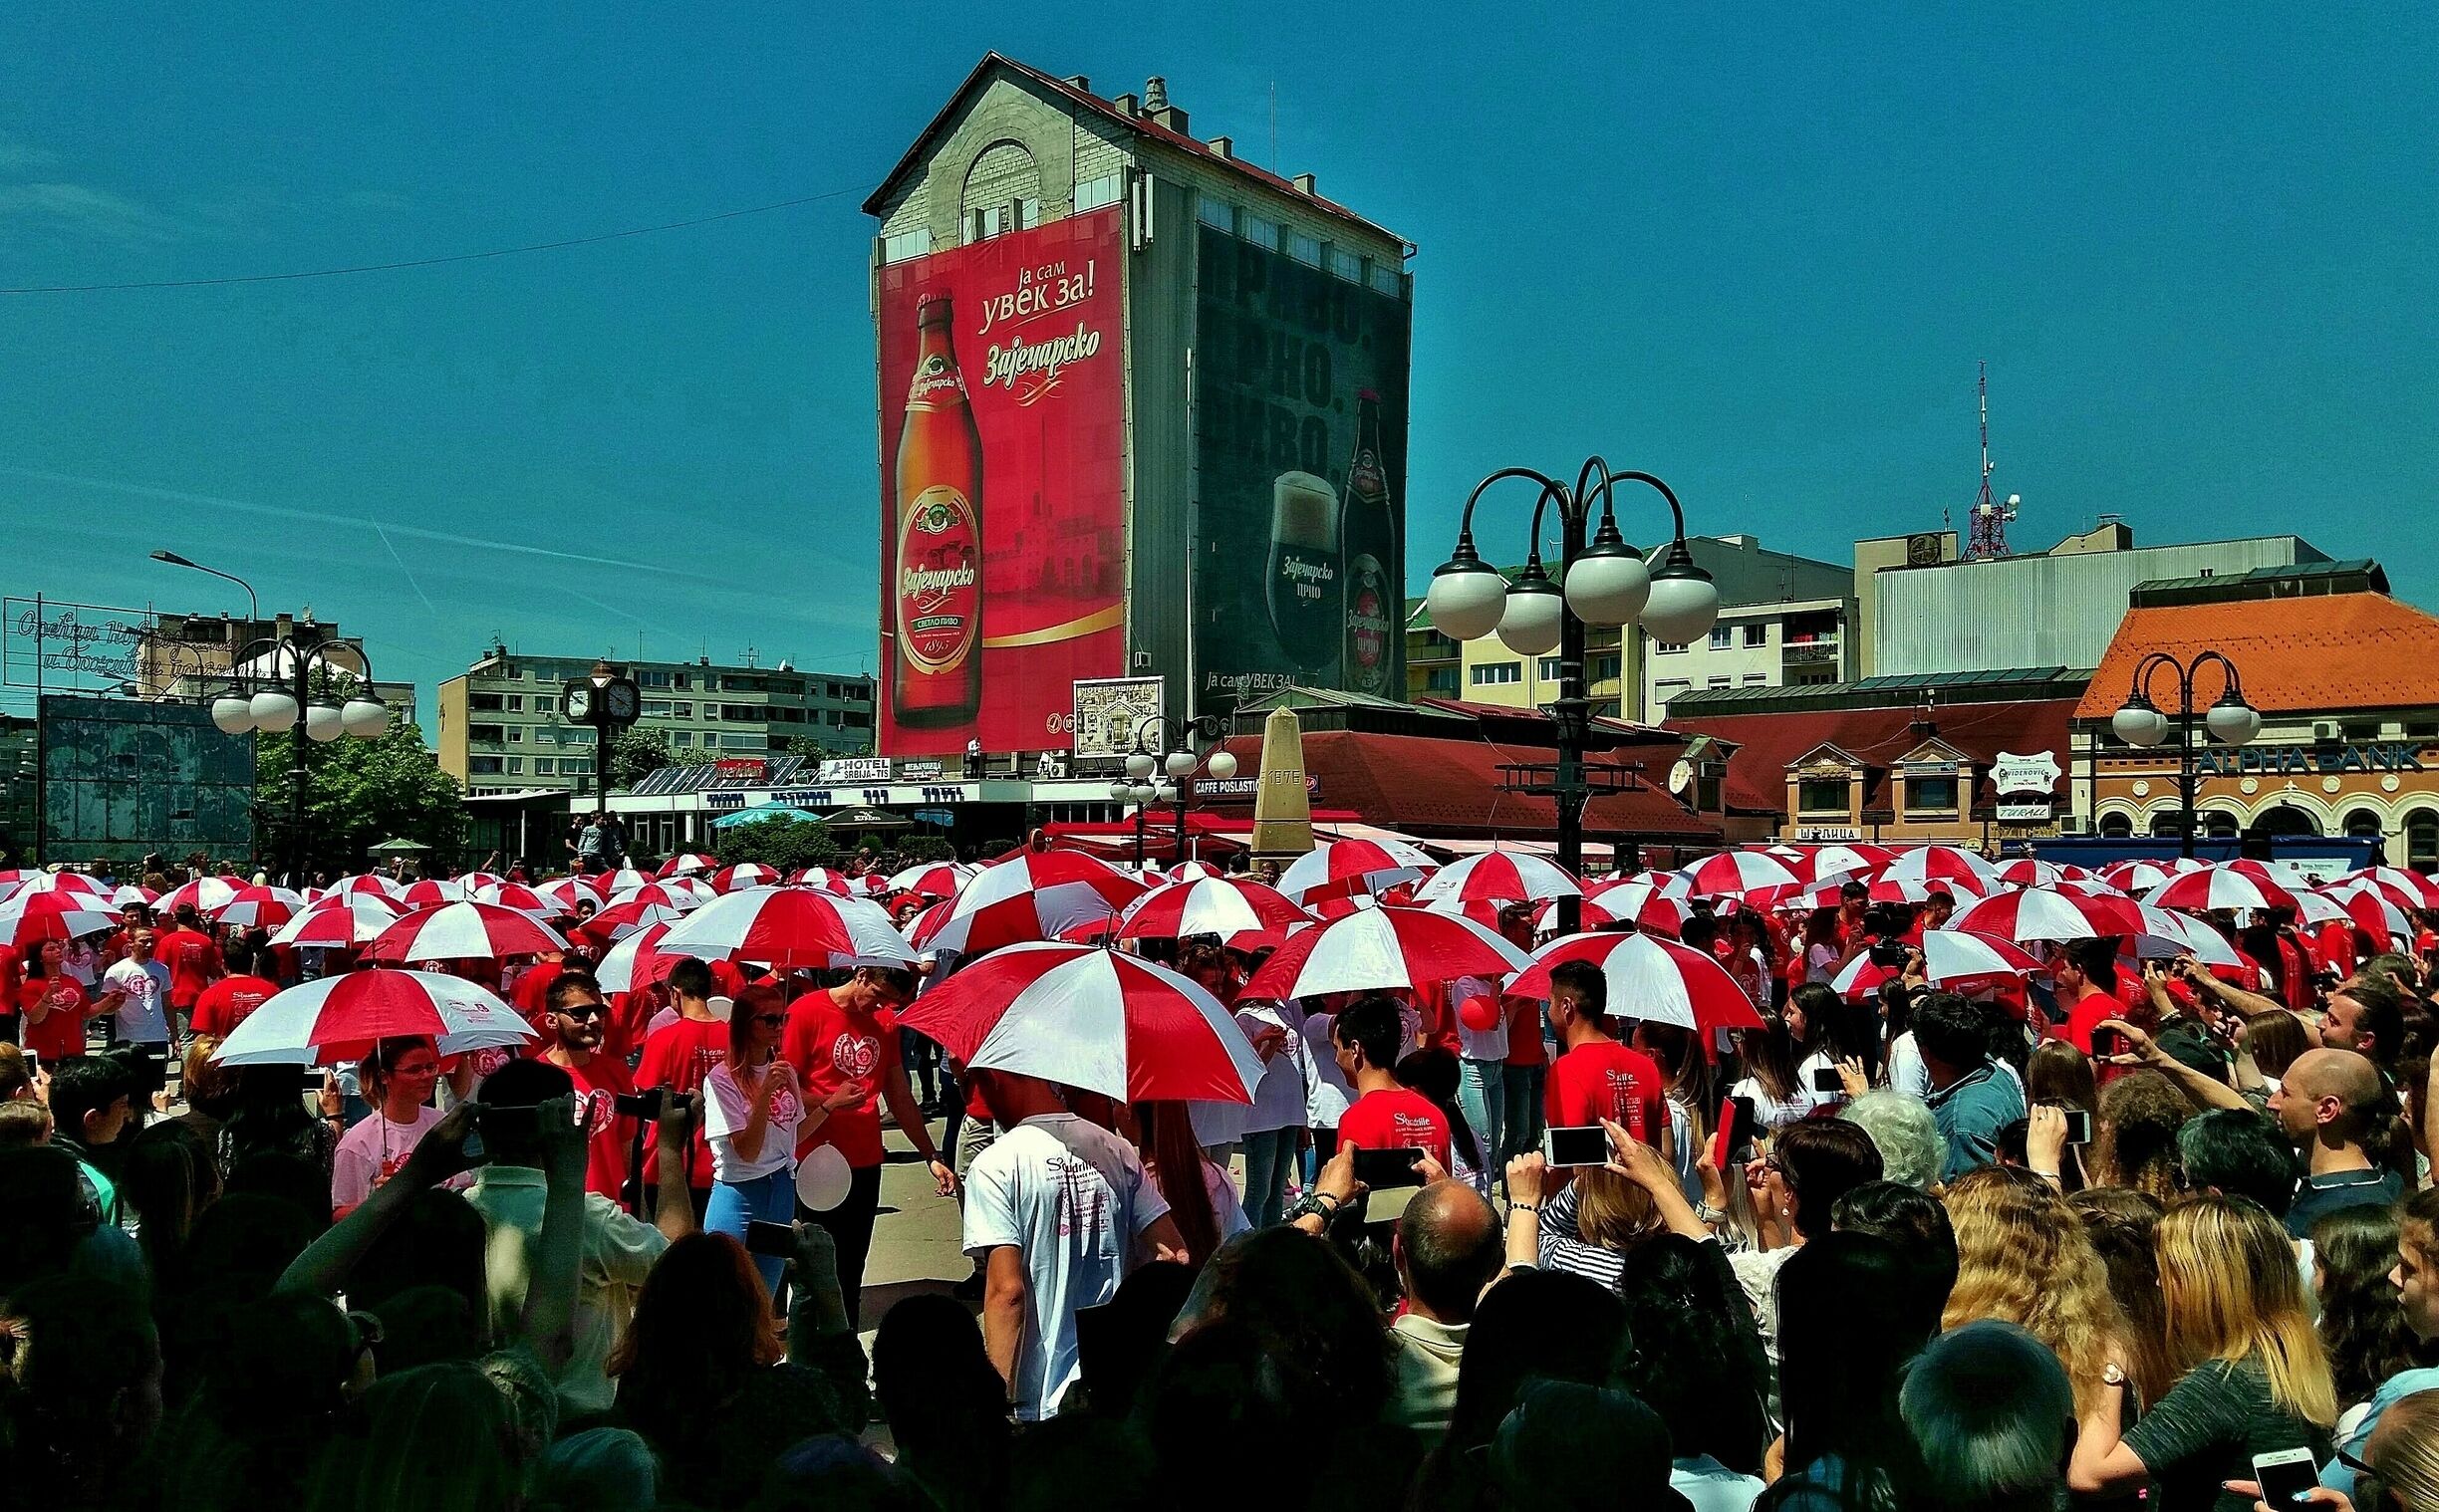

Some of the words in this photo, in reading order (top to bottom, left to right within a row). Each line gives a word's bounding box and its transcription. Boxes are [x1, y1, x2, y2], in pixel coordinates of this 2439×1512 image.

[1036, 260, 1066, 280] сам
[983, 320, 1101, 390] Зајечарско
[902, 560, 975, 599] Зајечарско
[1282, 556, 1335, 584] Зајечарско
[843, 759, 889, 770] HOTEL
[2195, 746, 2312, 775] ALPHA
[2317, 744, 2425, 772] BANK
[1196, 782, 1219, 794] CAFFE
[2000, 808, 2046, 817] TURALL
[1800, 828, 1855, 840] ШЉИЦА
